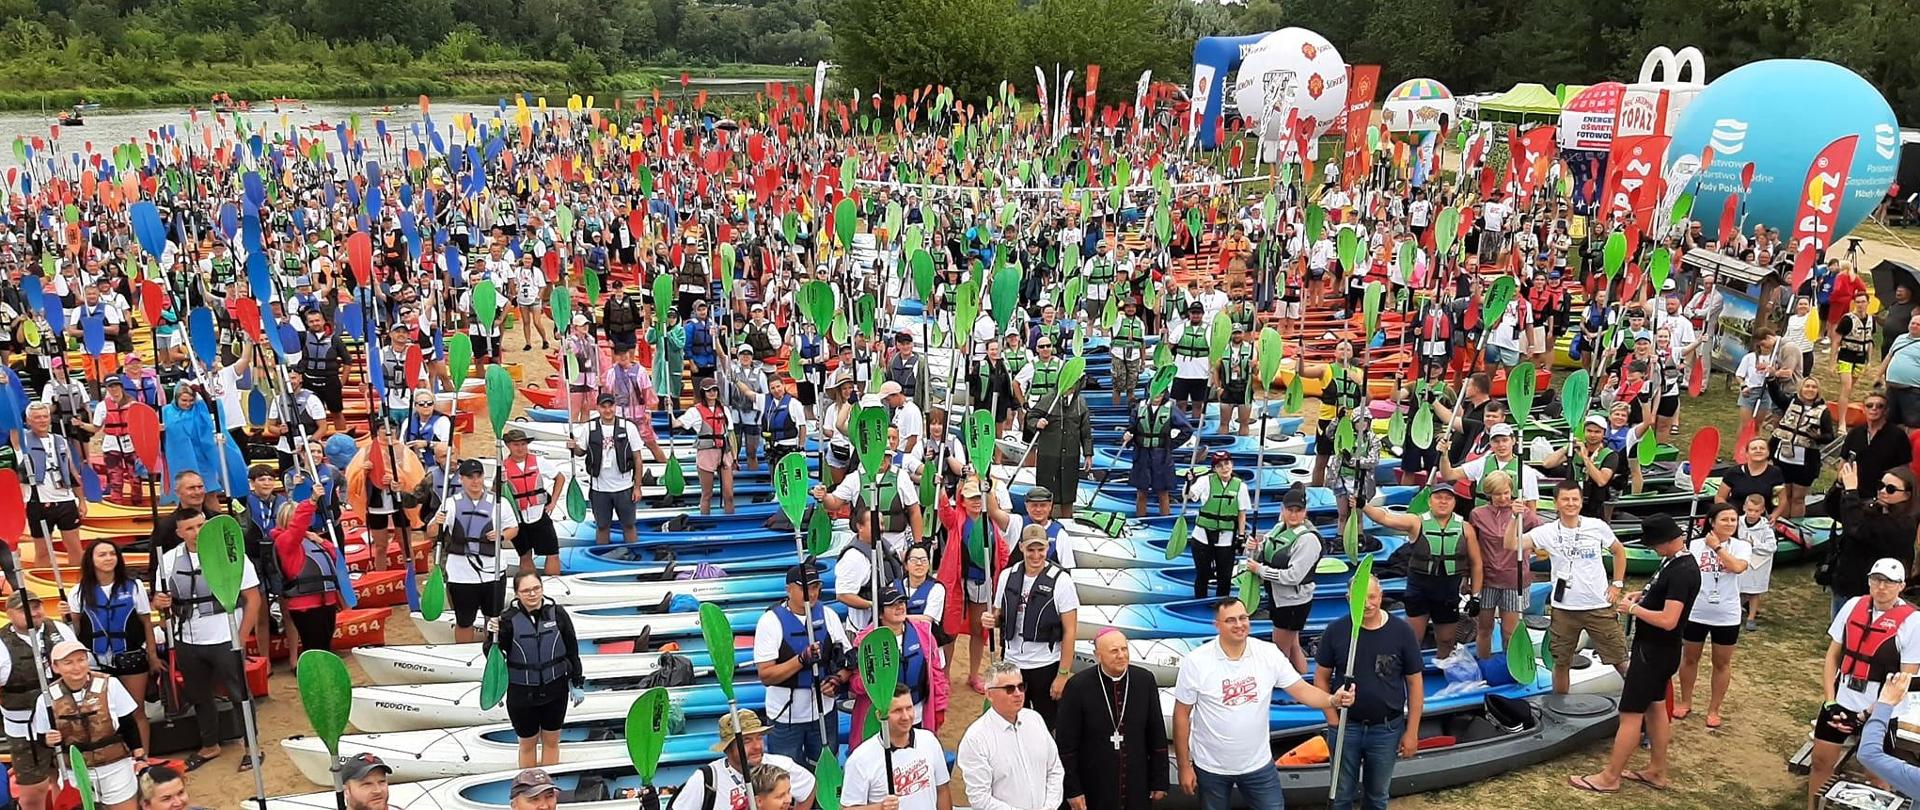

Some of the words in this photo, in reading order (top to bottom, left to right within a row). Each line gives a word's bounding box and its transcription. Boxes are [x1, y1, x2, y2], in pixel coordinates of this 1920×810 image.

[1621, 107, 1652, 130] TOPAZ
[1718, 183, 1752, 194] Polske
[375, 580, 405, 596] 814
[348, 619, 381, 635] 814
